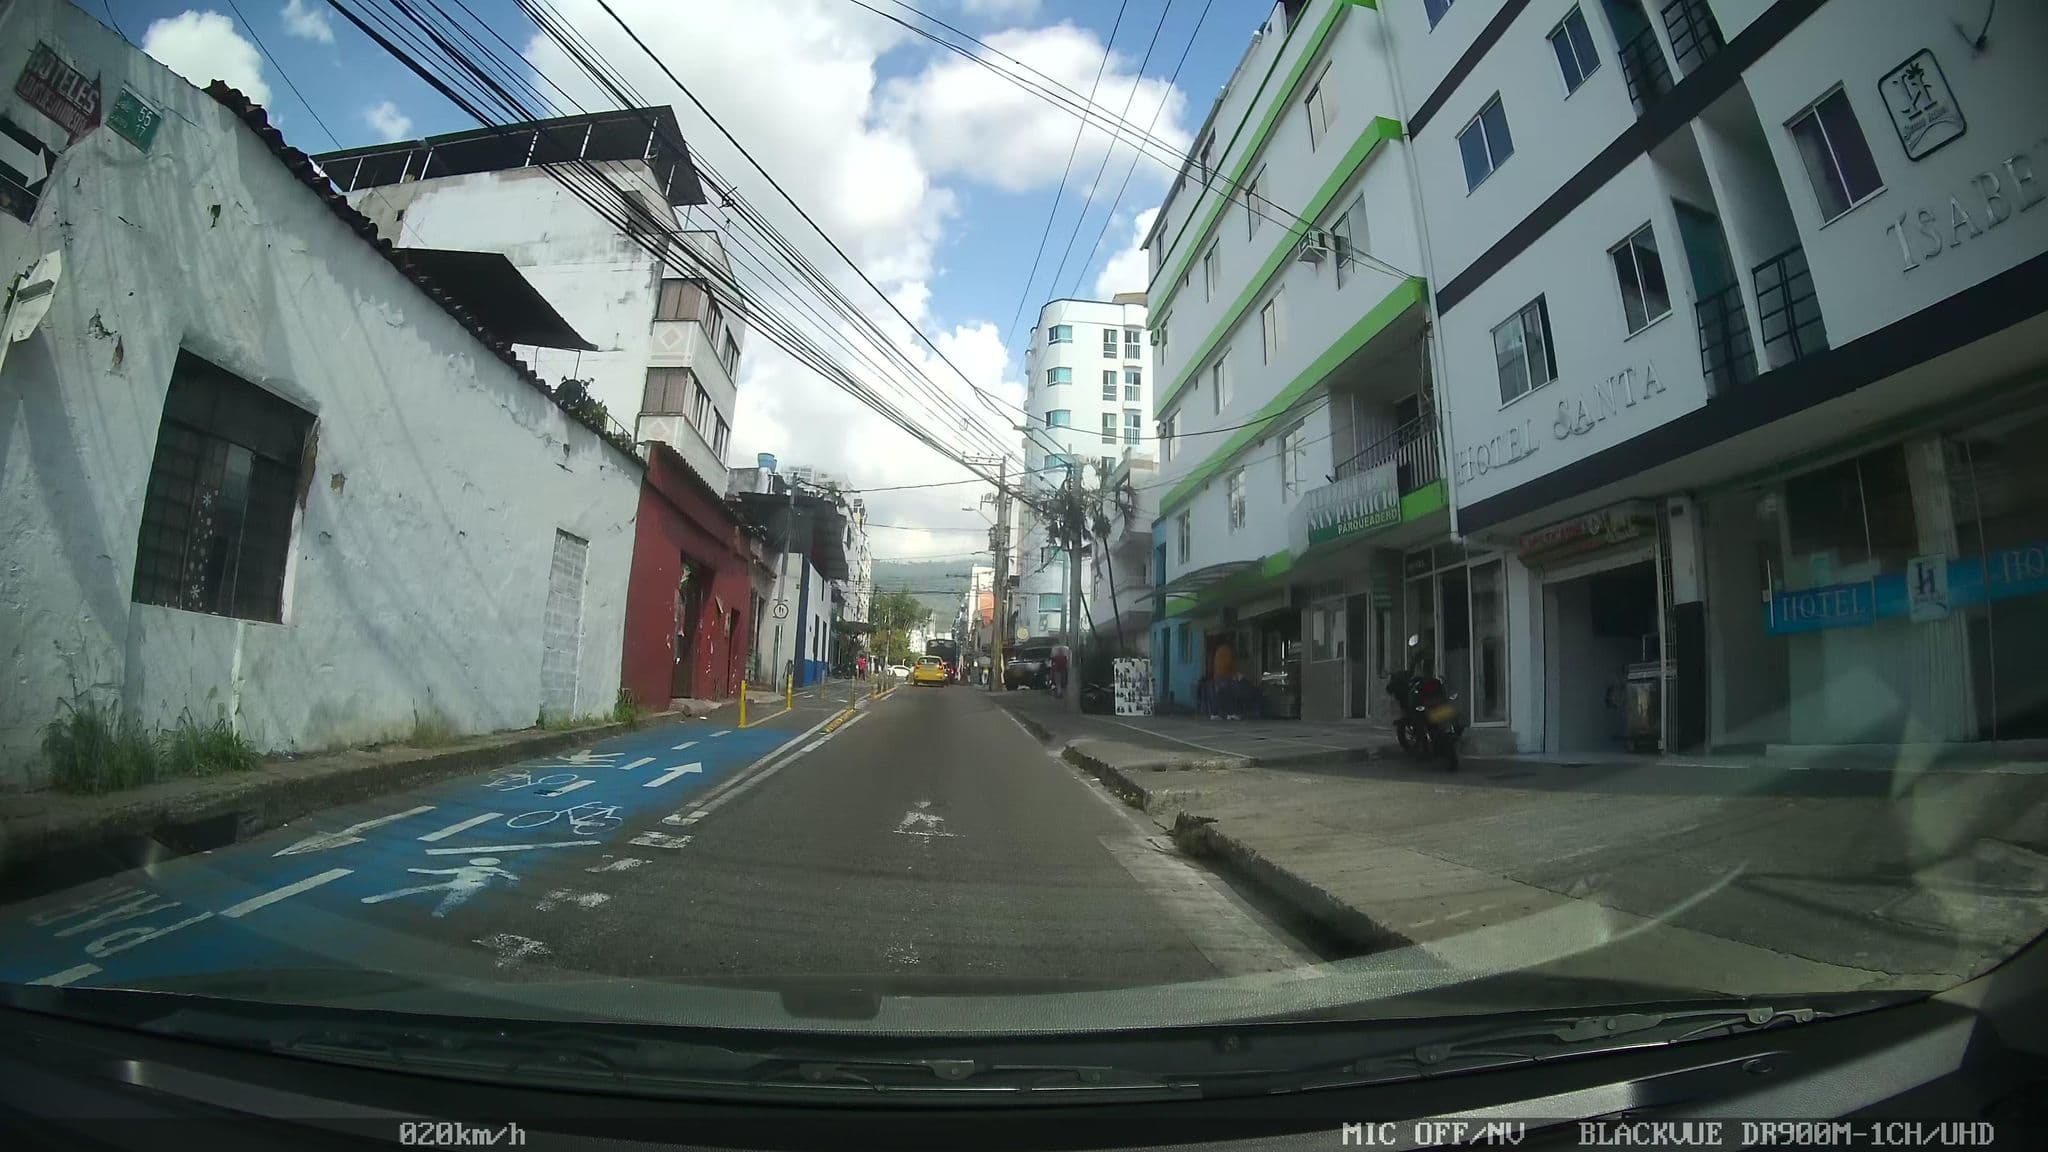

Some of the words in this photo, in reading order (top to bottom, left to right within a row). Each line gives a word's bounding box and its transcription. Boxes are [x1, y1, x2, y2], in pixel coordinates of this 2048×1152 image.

[1886, 138, 2048, 272] ISABE
[1456, 418, 1540, 488] HOTEL
[1553, 358, 1667, 441] SANTA
[1337, 508, 1398, 535] PARQUEADERO
[1780, 588, 1866, 622] HOTEL
